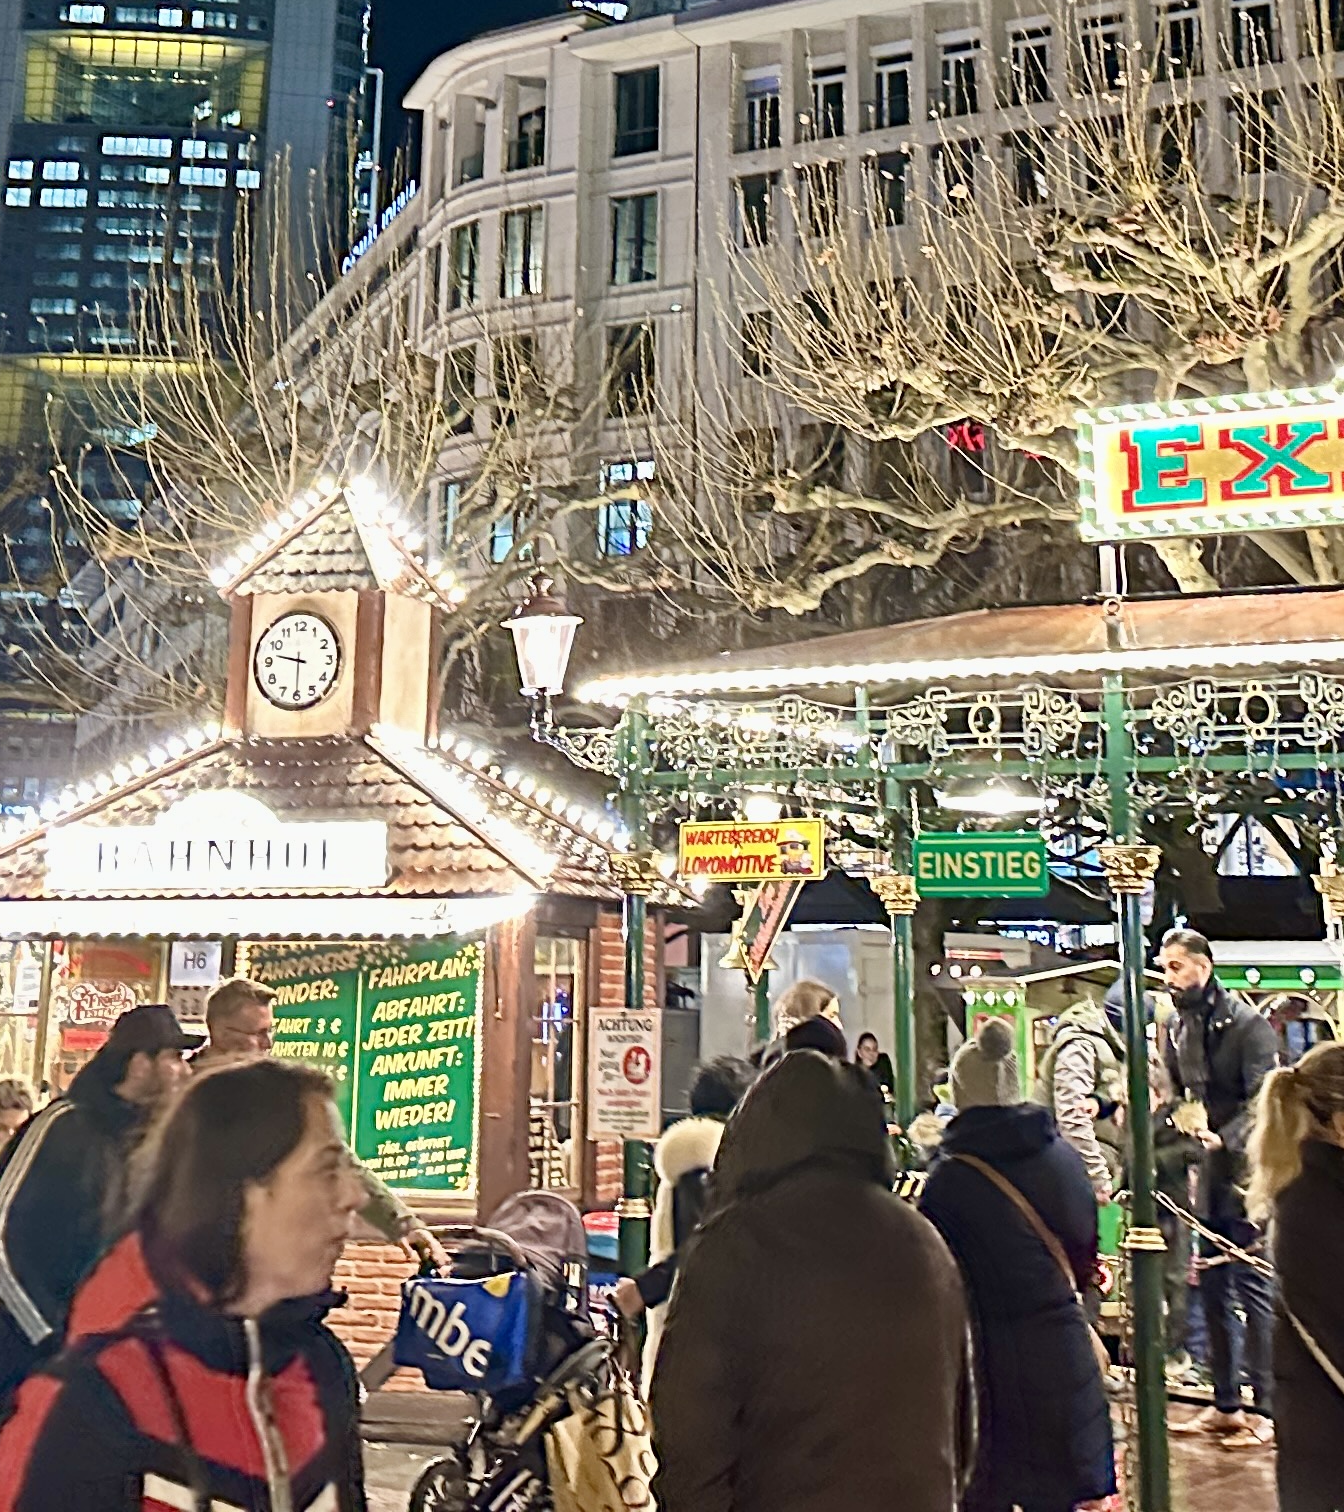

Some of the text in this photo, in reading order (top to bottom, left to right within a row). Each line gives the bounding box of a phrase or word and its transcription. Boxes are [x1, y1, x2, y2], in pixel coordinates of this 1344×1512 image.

[281, 627, 291, 638] 11
[294, 621, 308, 632] 12
[312, 627, 317, 638] 1
[269, 639, 284, 651] 10
[319, 638, 329, 650] 2
[264, 656, 274, 668] 9
[324, 654, 334, 666] 3
[267, 673, 277, 685] 8
[318, 671, 328, 683] 4
[278, 686, 288, 698] 7
[292, 689, 302, 702] 6
[307, 685, 317, 697] 5
[685, 828, 779, 846] WARTEBEREICH
[683, 854, 777, 875] LOKOMOTIVE
[918, 851, 1041, 879] EINSTIEG
[184, 952, 207, 970] H6
[368, 957, 471, 990] FAHRPLAN:
[272, 978, 339, 1006] INDER:
[372, 992, 466, 1023] ABFAHRT:
[316, 1018, 326, 1034] 3
[598, 1018, 653, 1032] ACHTUNG
[362, 1023, 421, 1051] JEDER
[322, 1041, 336, 1058] 10
[370, 1045, 464, 1076] ANKUNFT:
[383, 1074, 450, 1102] IMMER
[375, 1099, 456, 1130] WIEDER!
